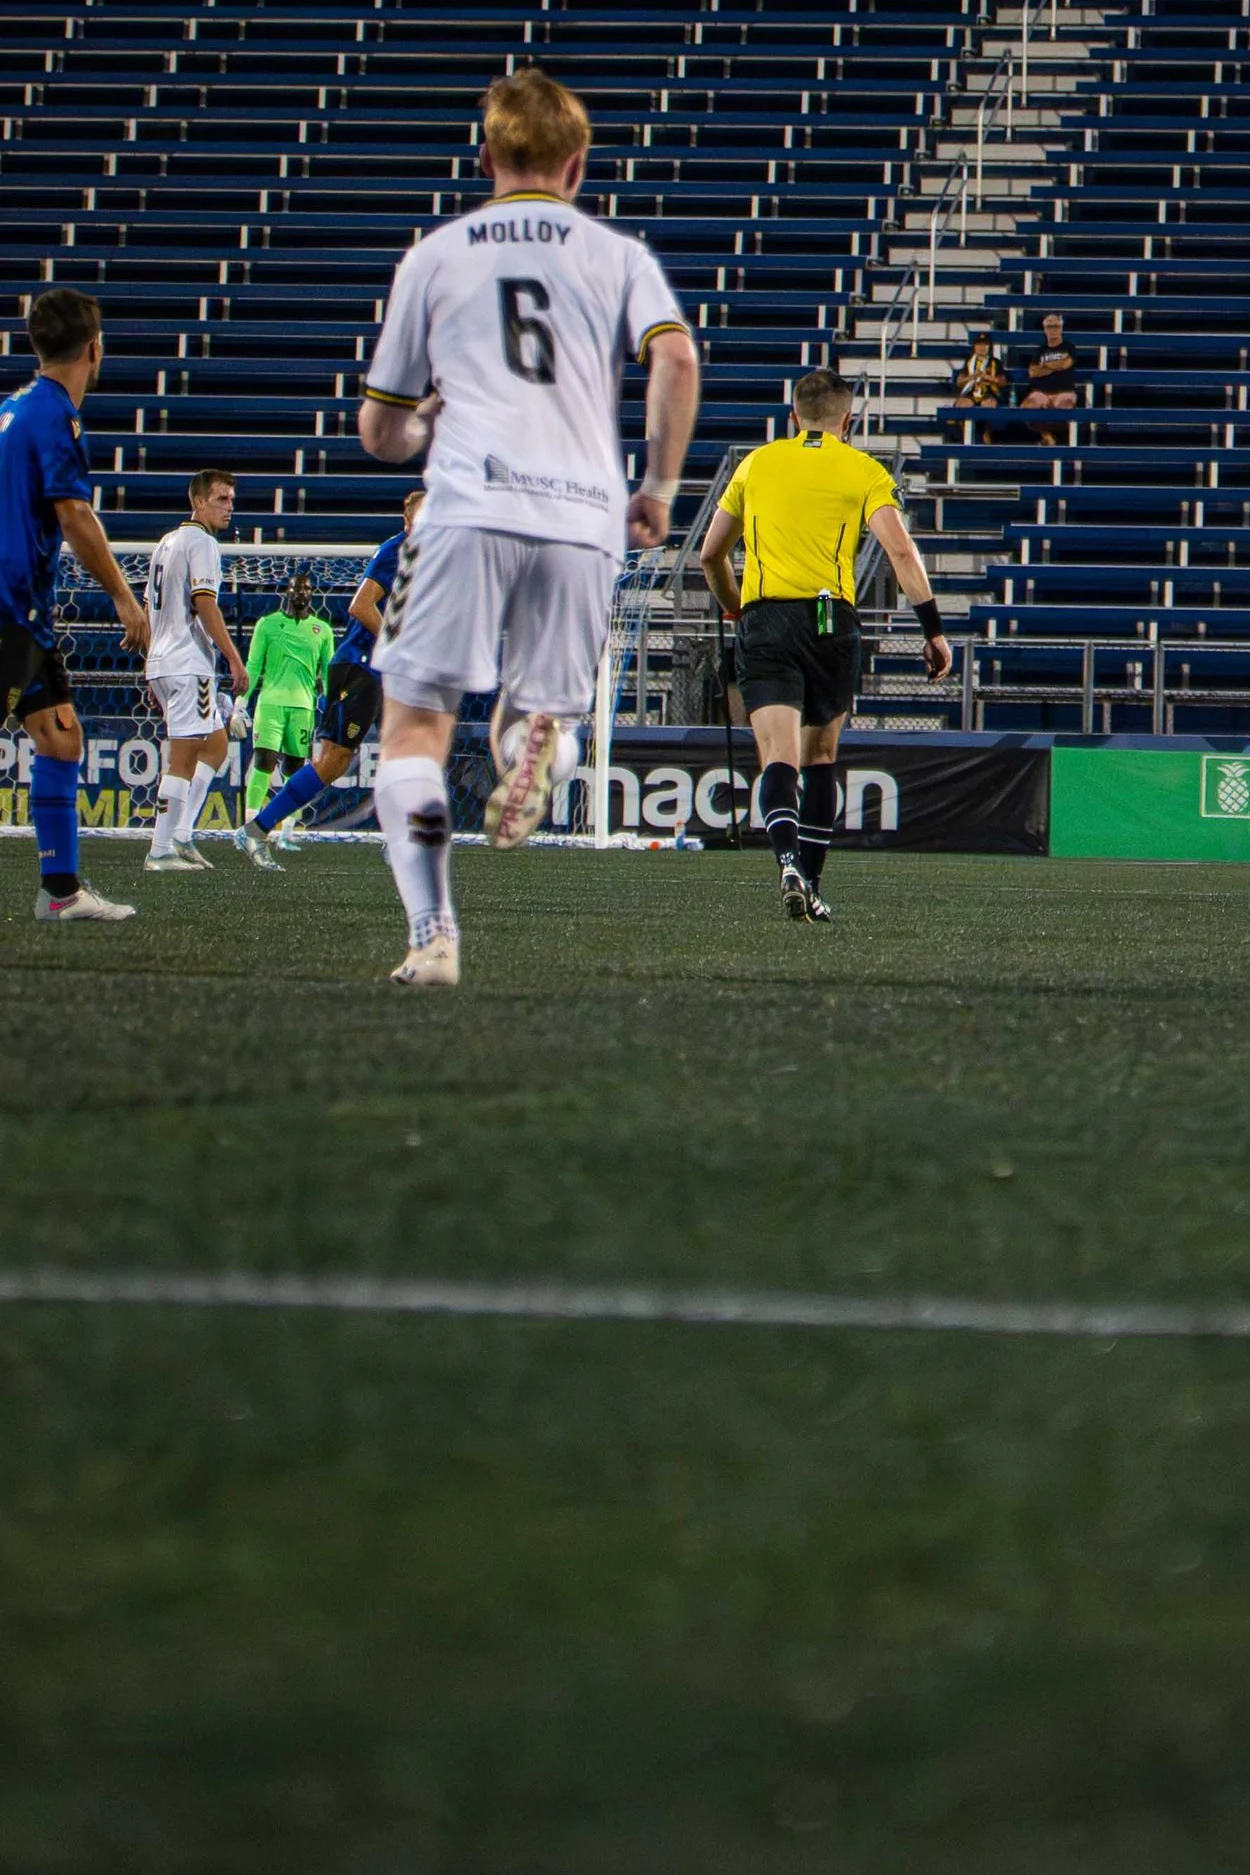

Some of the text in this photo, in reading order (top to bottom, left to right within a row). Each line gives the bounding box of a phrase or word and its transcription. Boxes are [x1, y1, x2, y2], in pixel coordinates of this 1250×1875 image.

[467, 217, 572, 246] MOLLOY
[496, 276, 556, 385] 6
[551, 766, 898, 831] macn
